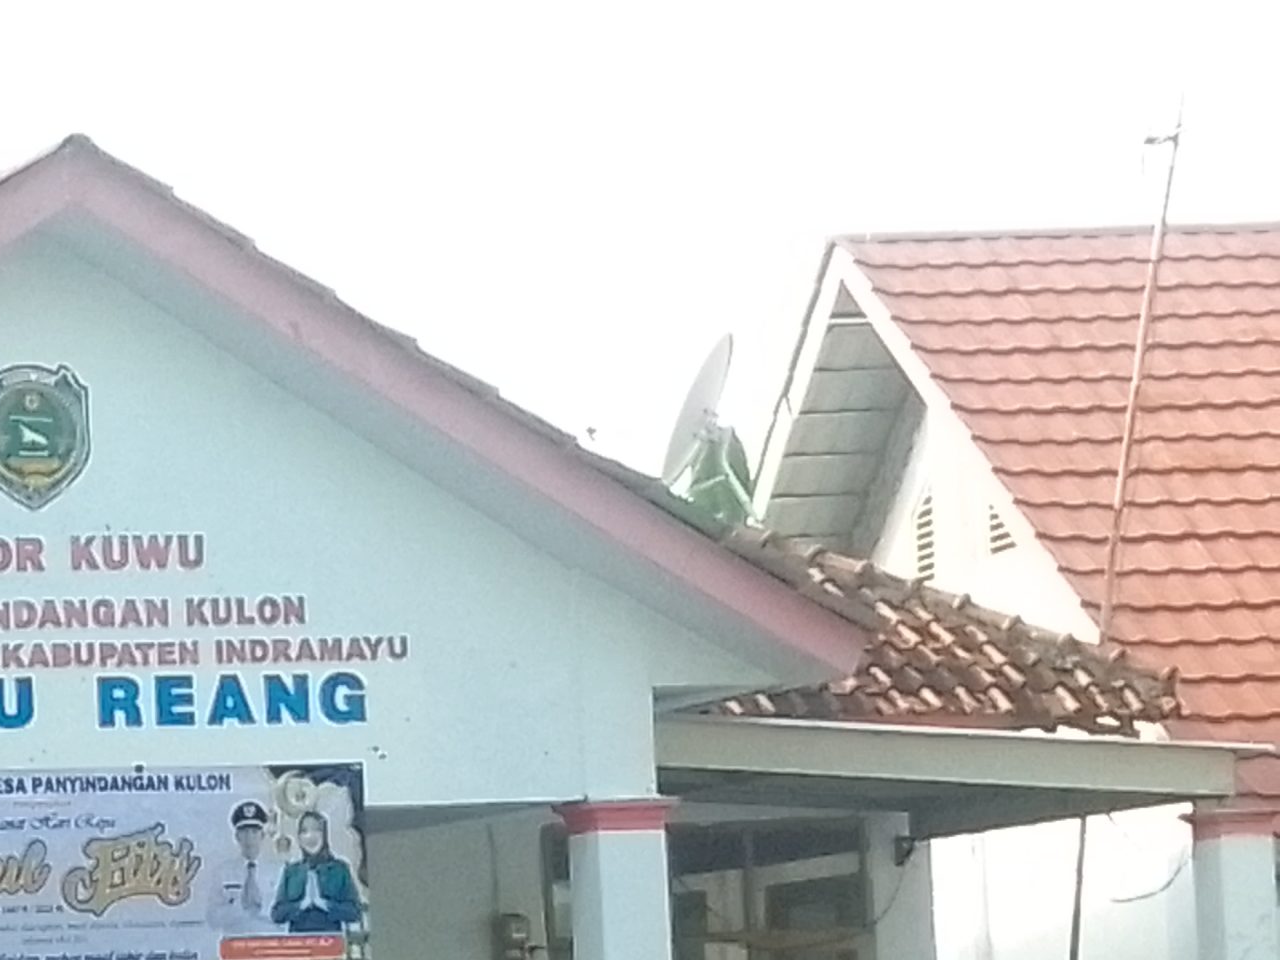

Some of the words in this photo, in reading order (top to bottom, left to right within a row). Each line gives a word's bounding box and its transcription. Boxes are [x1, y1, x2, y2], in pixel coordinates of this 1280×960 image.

[70, 534, 204, 571] KUWU
[186, 596, 306, 626] KULON
[1, 639, 199, 668] KABUPATEN
[214, 635, 408, 663] INDRAMAYU
[96, 672, 368, 728] REANG
[31, 775, 169, 793] PANYINDANGAN
[174, 774, 231, 791] KULON
[62, 822, 202, 916] Fitri
